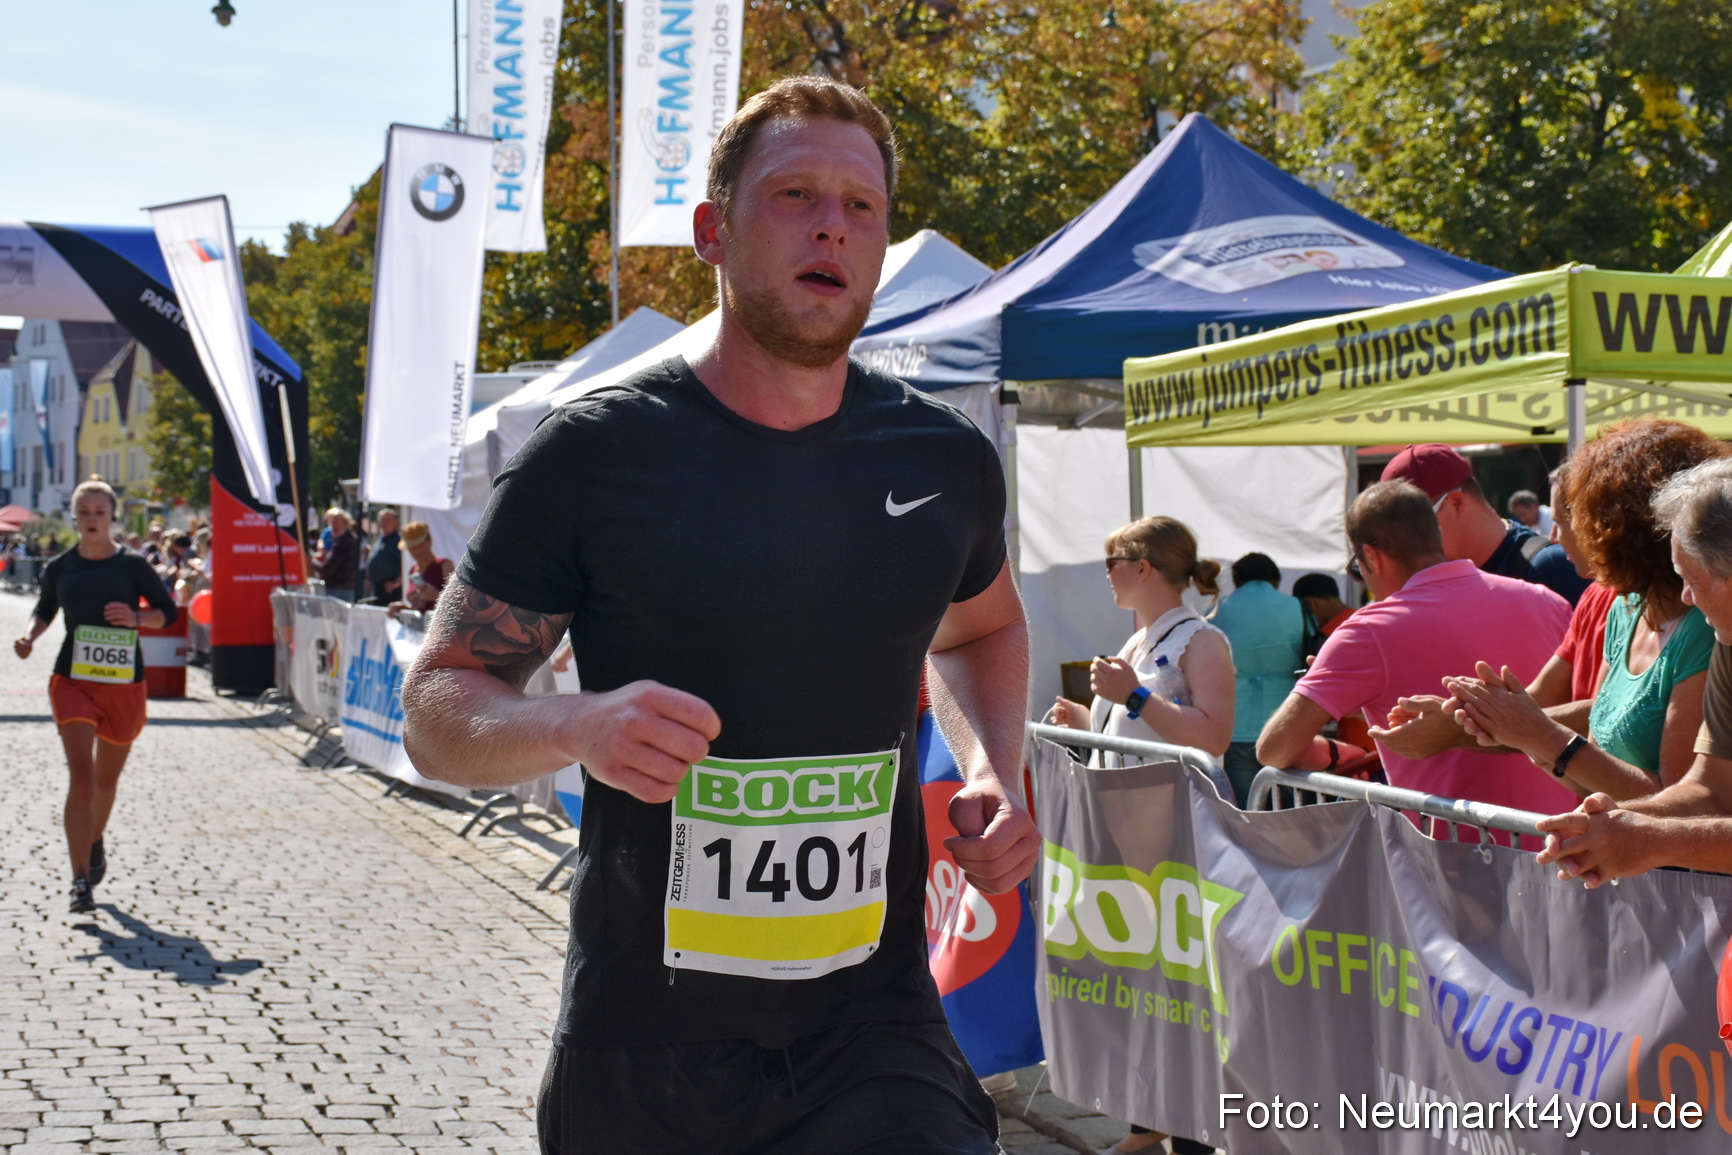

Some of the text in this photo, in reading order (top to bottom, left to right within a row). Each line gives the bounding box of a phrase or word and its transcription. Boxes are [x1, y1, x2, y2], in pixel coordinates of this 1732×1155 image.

[654, 0, 693, 206] HOFMAN
[1127, 292, 1556, 429] www.jumpers-fitness.com
[450, 360, 467, 448] NEUMARKT
[81, 629, 129, 644] BOCK
[82, 646, 129, 665] 1068
[694, 764, 882, 815] BOCK
[702, 831, 867, 902] 1401
[1115, 976, 1140, 1019] by
[1272, 924, 1420, 1018] OFFICE
